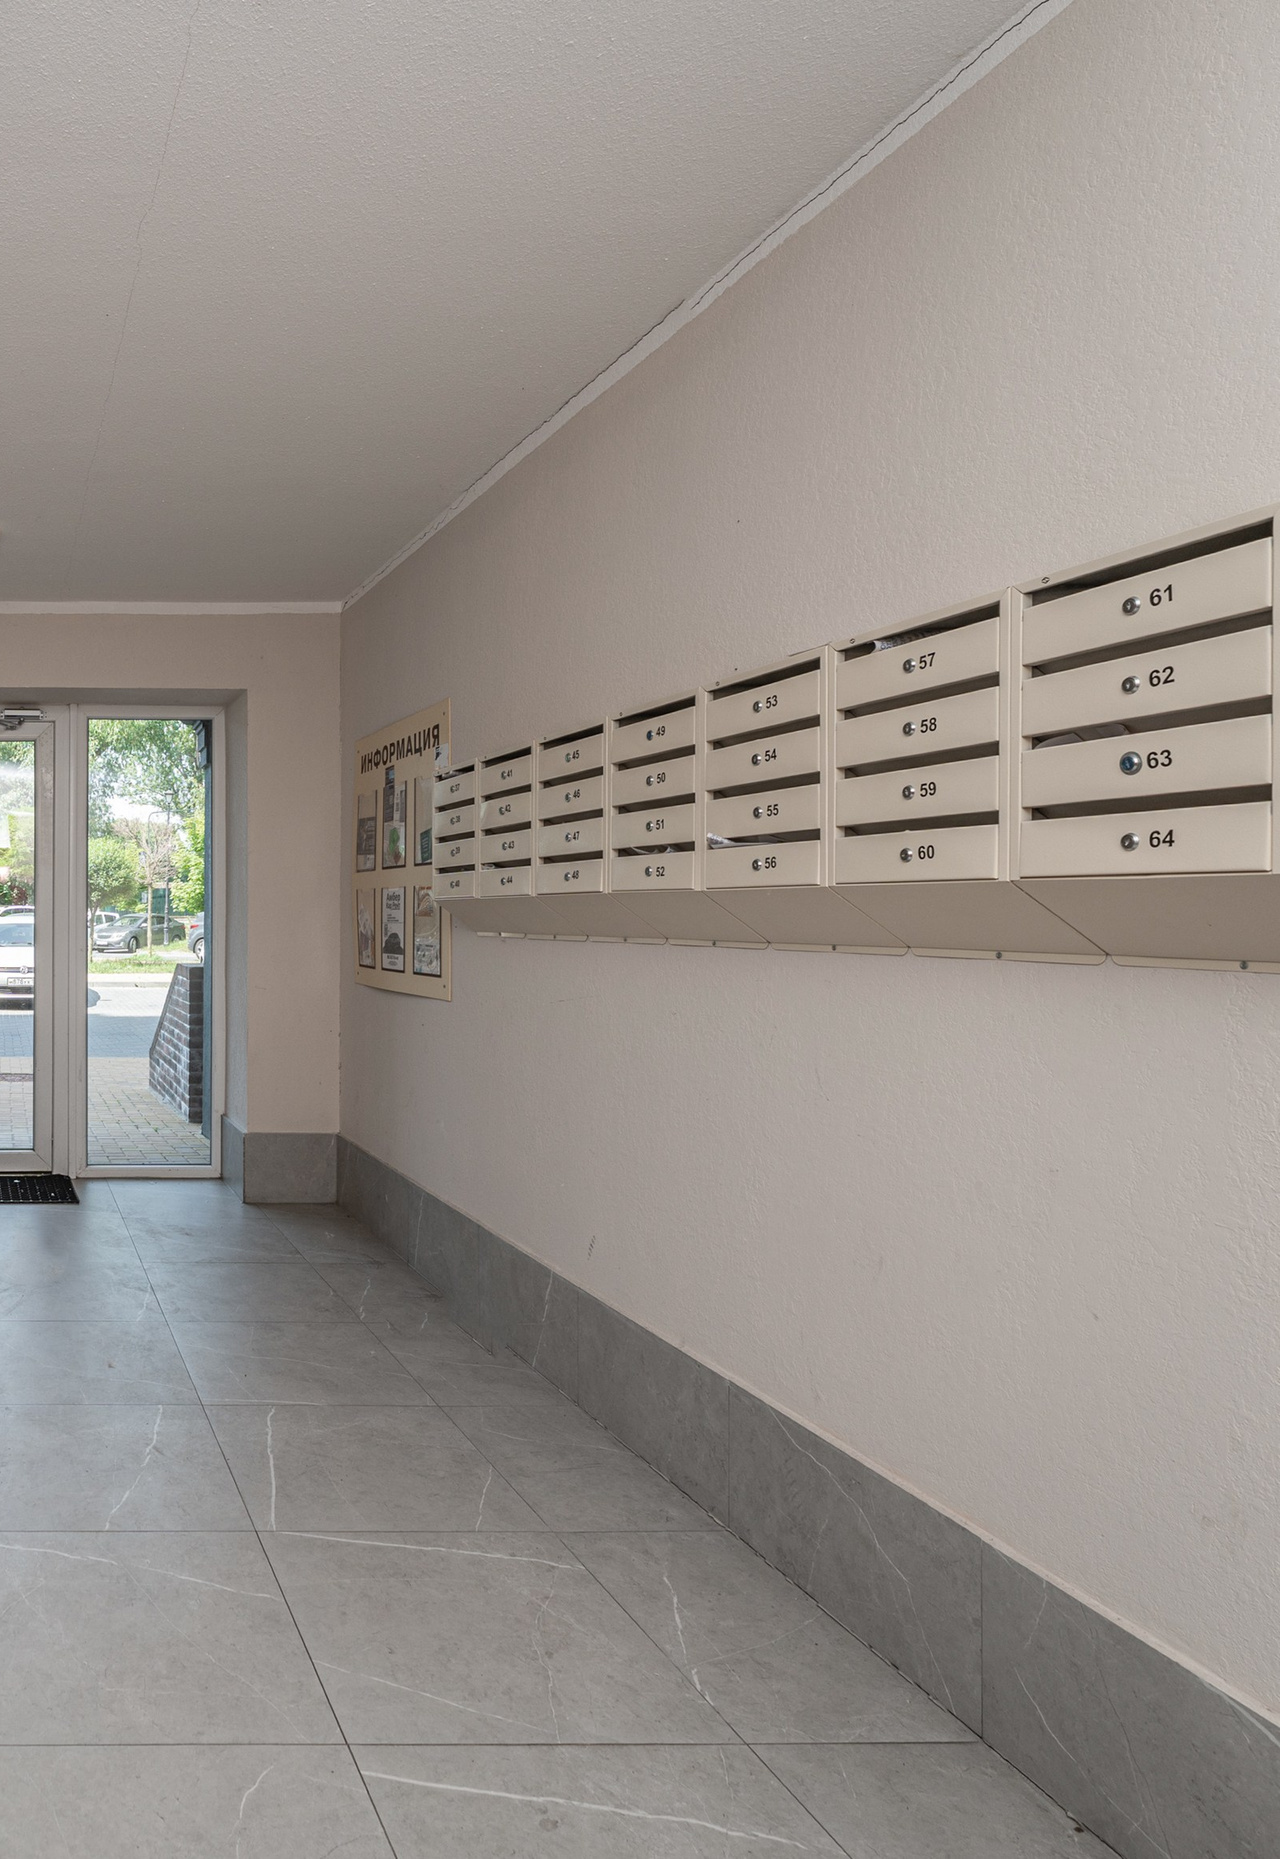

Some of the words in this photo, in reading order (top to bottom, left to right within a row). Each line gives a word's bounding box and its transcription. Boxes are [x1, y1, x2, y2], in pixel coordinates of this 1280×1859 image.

[1149, 583, 1173, 607] 61
[918, 651, 936, 670] 57
[1148, 665, 1176, 688] 62
[765, 694, 778, 710] 53
[655, 725, 666, 737] 49
[919, 716, 938, 734] 58
[361, 723, 440, 774] ИНФОРМАЦИЯ
[571, 749, 580, 760] 45
[764, 747, 778, 763] 54
[1146, 749, 1173, 770] 63
[506, 769, 513, 777] 41
[656, 771, 666, 784] 50
[572, 788, 581, 799] 46
[919, 781, 937, 798] 59
[505, 803, 512, 813] 42
[766, 803, 779, 817] 55
[655, 818, 665, 831] 51
[572, 830, 580, 841] 47
[1148, 828, 1176, 849] 64
[507, 840, 515, 849] 43
[917, 844, 935, 860] 60
[764, 856, 777, 870] 56
[571, 869, 580, 880] 48
[655, 865, 666, 878] 52
[506, 875, 513, 884] 44
